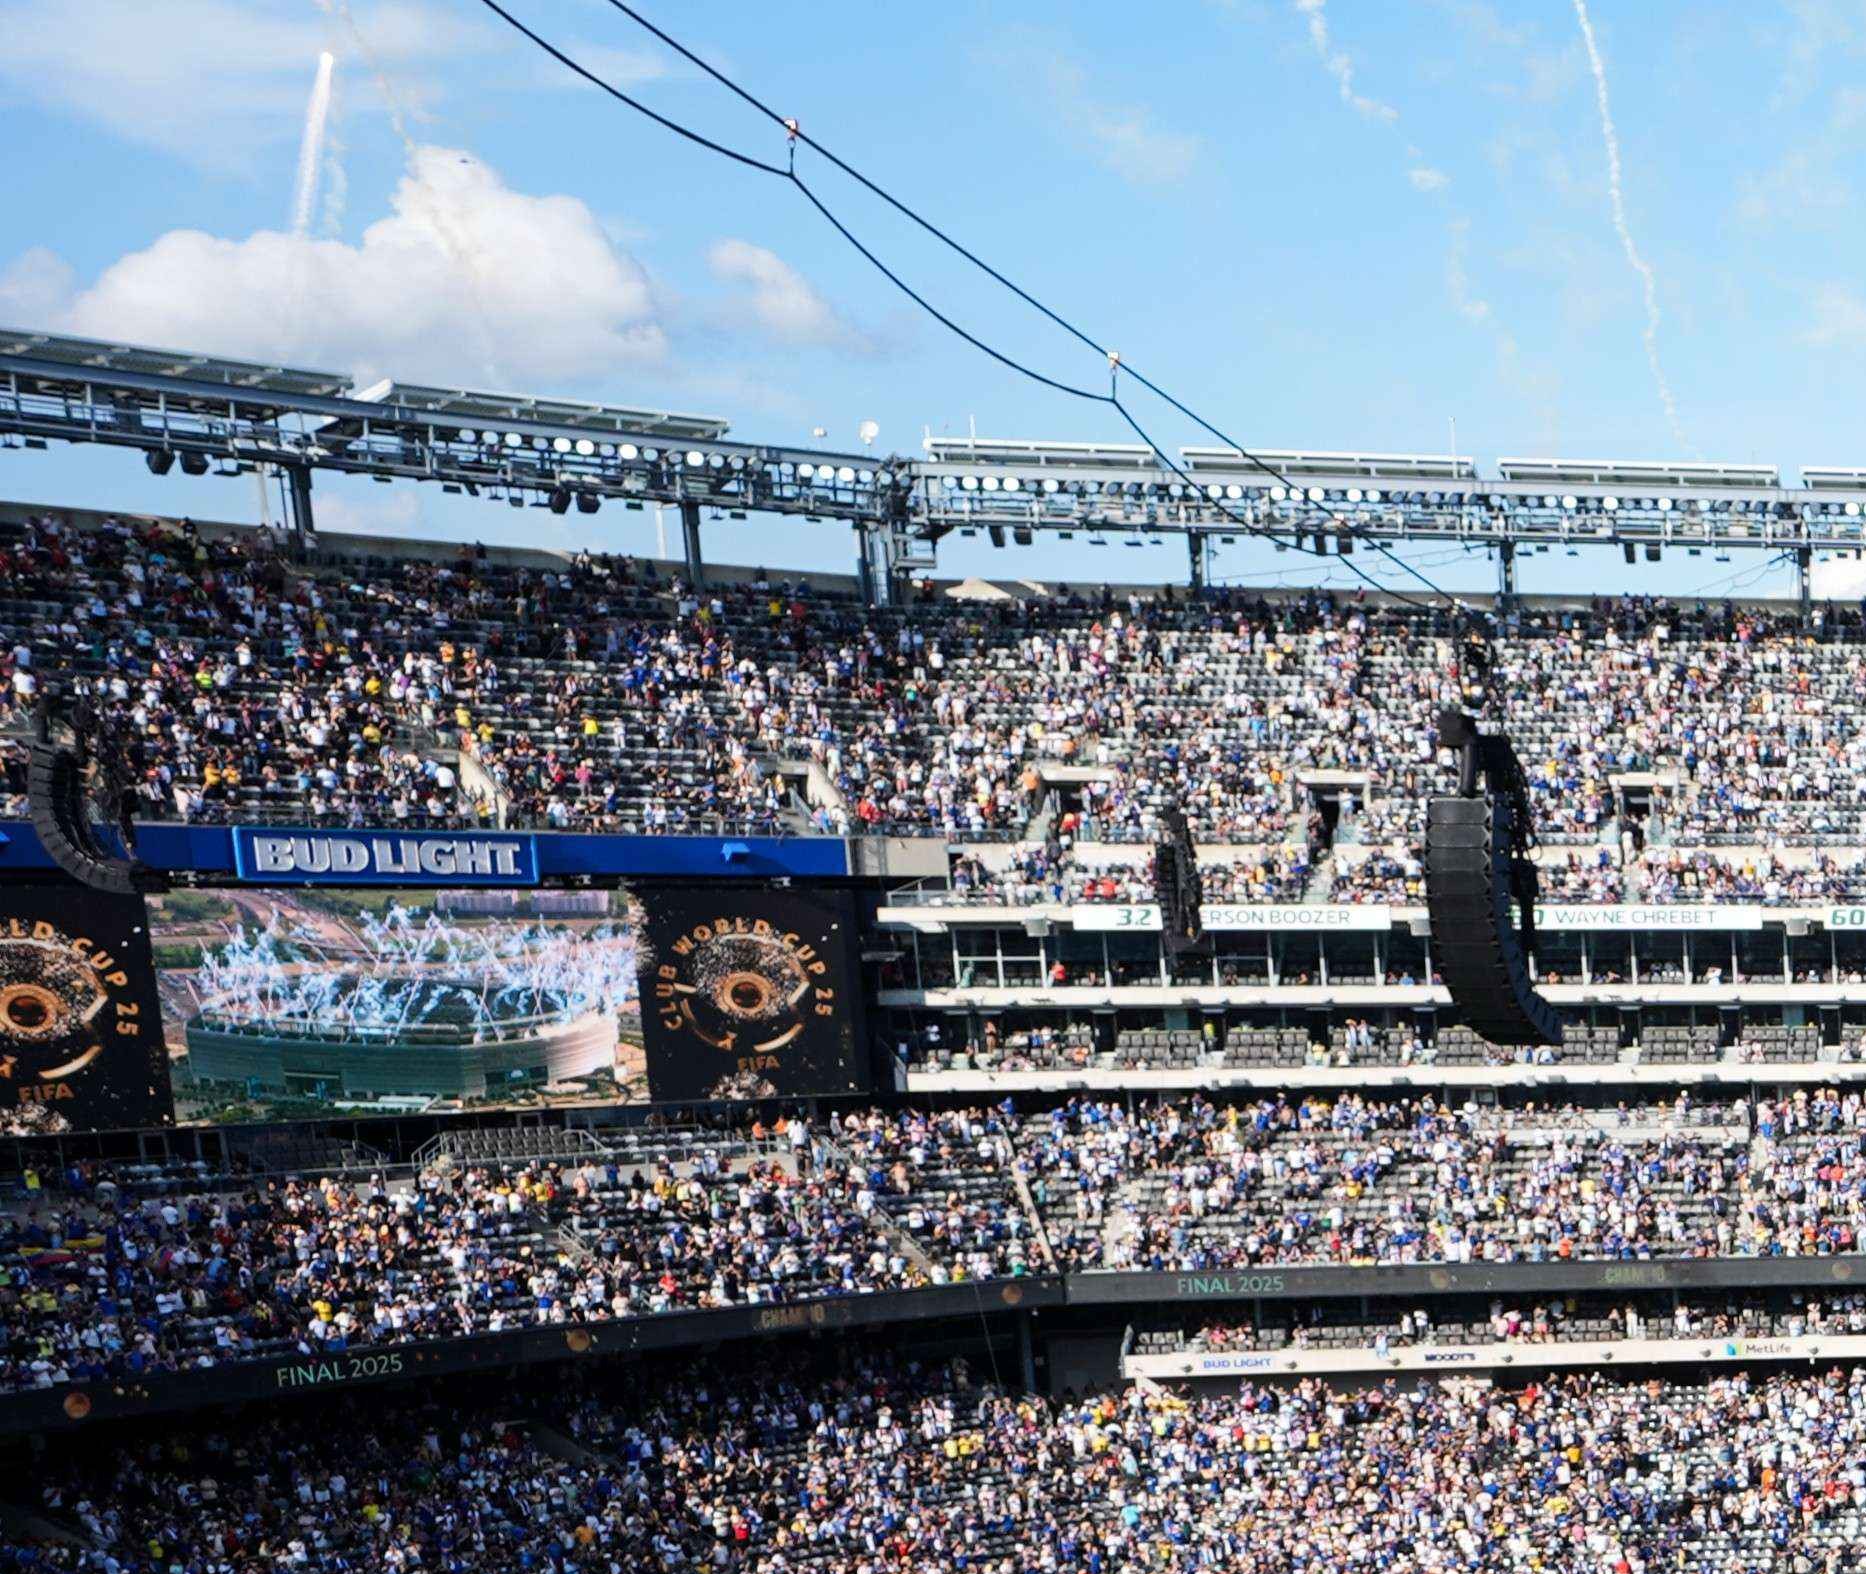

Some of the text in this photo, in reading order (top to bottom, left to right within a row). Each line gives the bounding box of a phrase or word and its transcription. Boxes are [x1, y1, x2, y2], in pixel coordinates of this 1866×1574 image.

[254, 836, 522, 876] BUD LIGHT
[1116, 909, 1352, 927] 32 ERSON BOOZER
[1554, 910, 1627, 925] WAYNE
[1631, 910, 1718, 925] CHREBET
[1831, 908, 1865, 926] 60
[18, 1083, 75, 1102] FIFA
[1176, 1275, 1285, 1293] FINAL 2025
[1745, 1343, 1792, 1354] MetLife
[276, 1353, 404, 1389] FINAL 2025
[1202, 1356, 1273, 1370] BUD LIGHT
